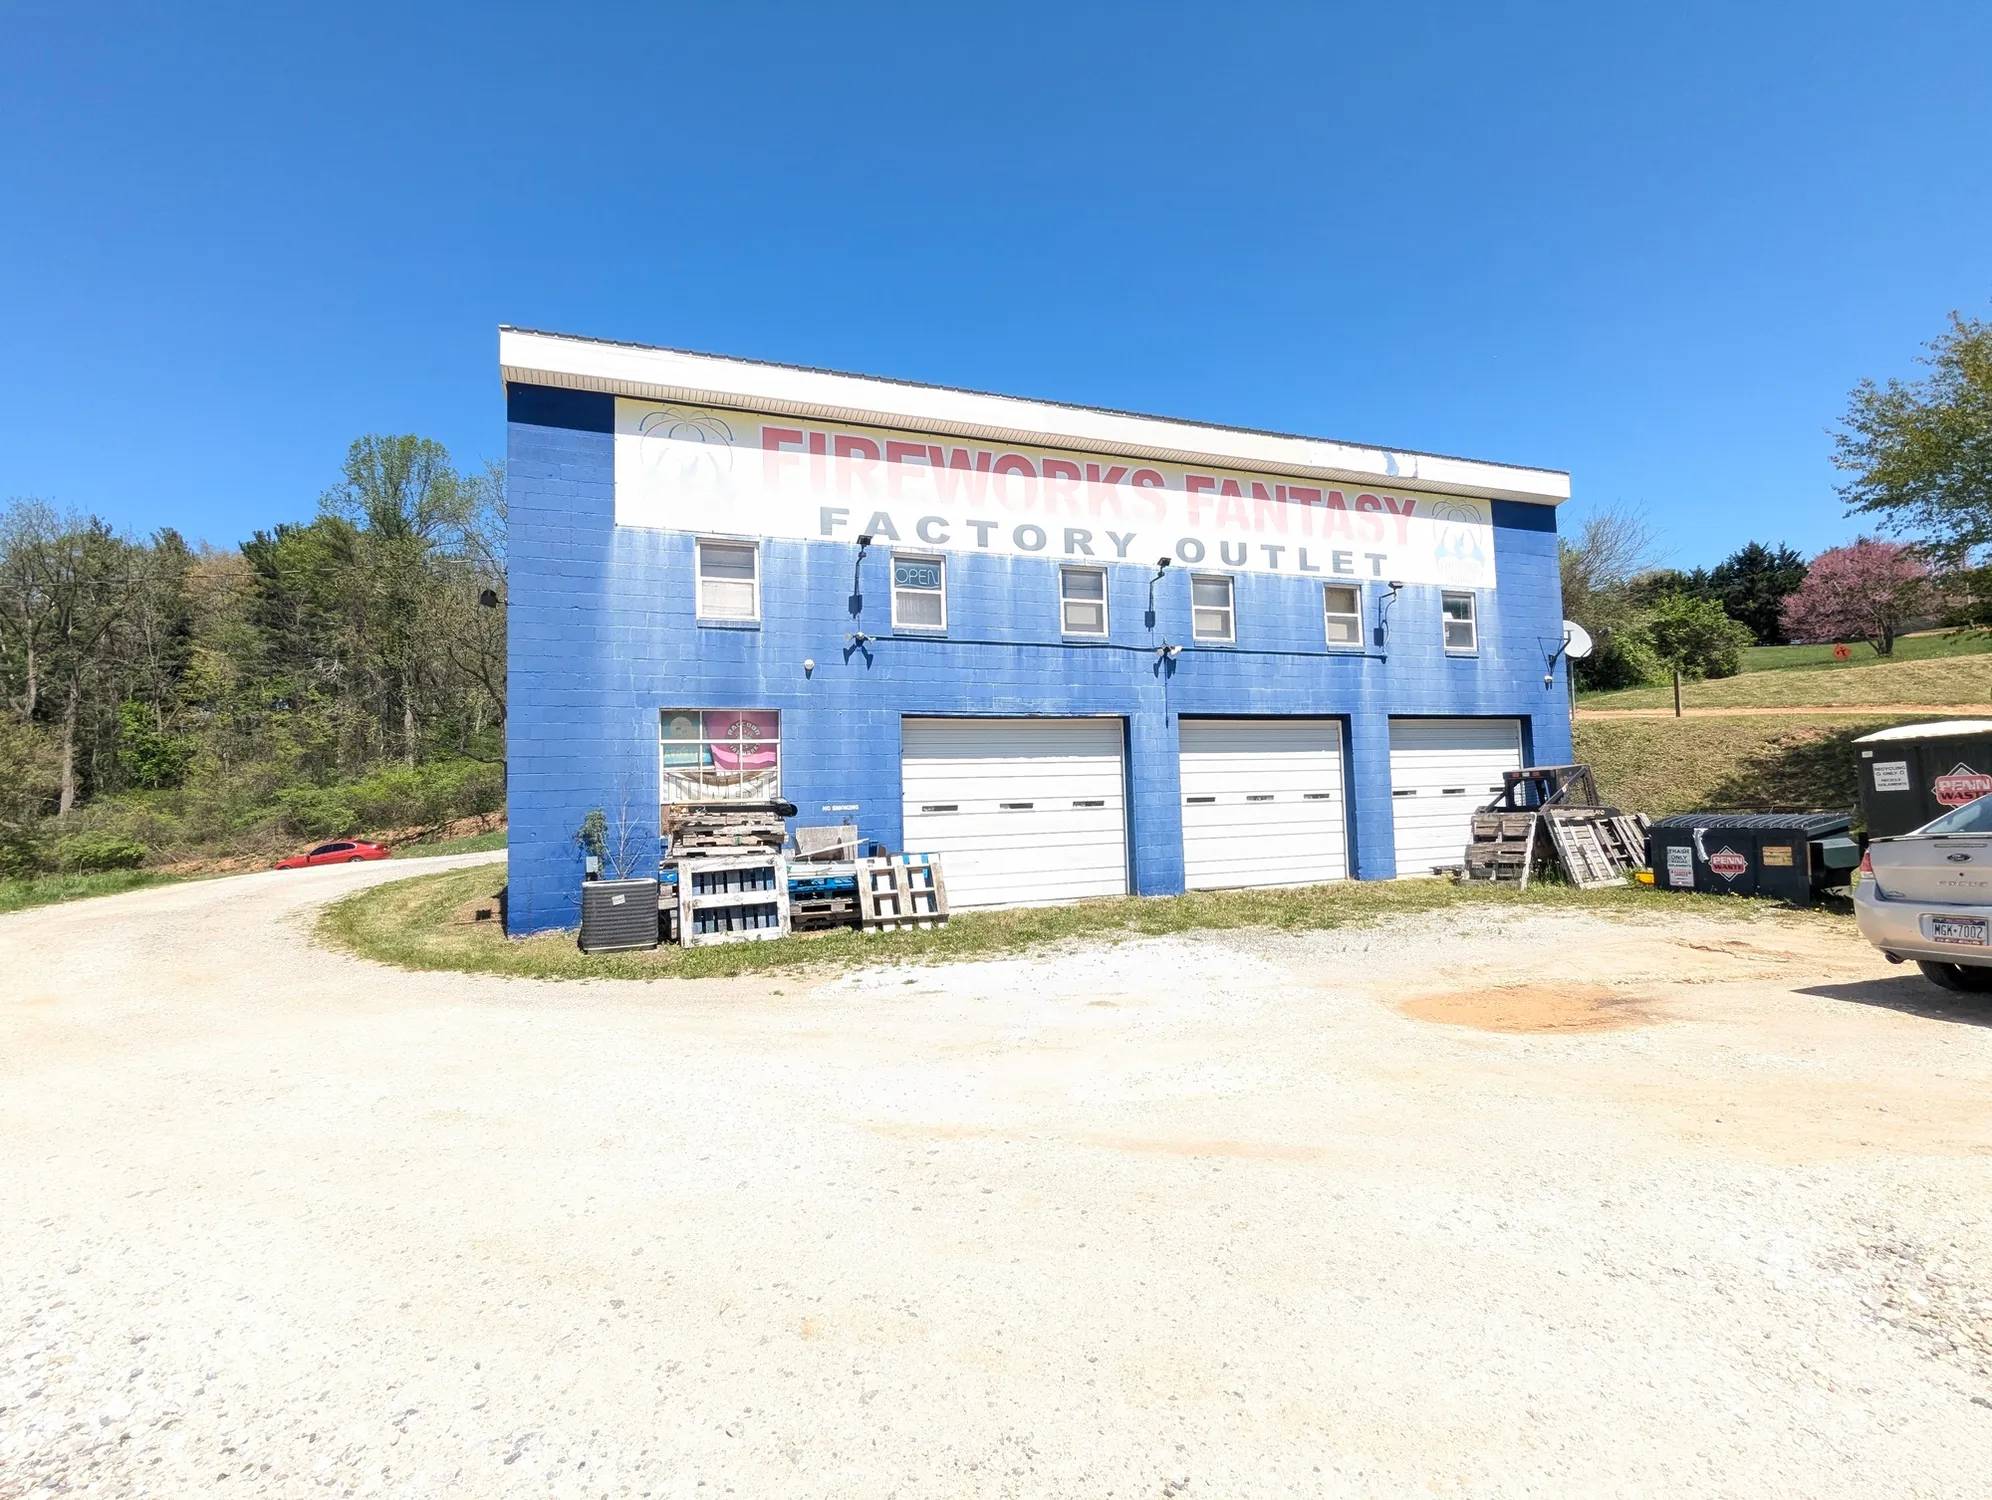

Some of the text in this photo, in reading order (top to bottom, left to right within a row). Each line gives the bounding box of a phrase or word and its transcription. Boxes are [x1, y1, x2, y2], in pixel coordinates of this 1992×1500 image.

[762, 425, 1417, 546] FIREWORKS FANTASY
[819, 505, 1137, 558] FACTORY
[1175, 537, 1388, 577] OUTLET
[895, 567, 940, 585] OPEN
[728, 721, 762, 737] RACCOON
[1938, 778, 1991, 791] PENN
[822, 804, 832, 812] NO
[1712, 856, 1743, 865] PENN
